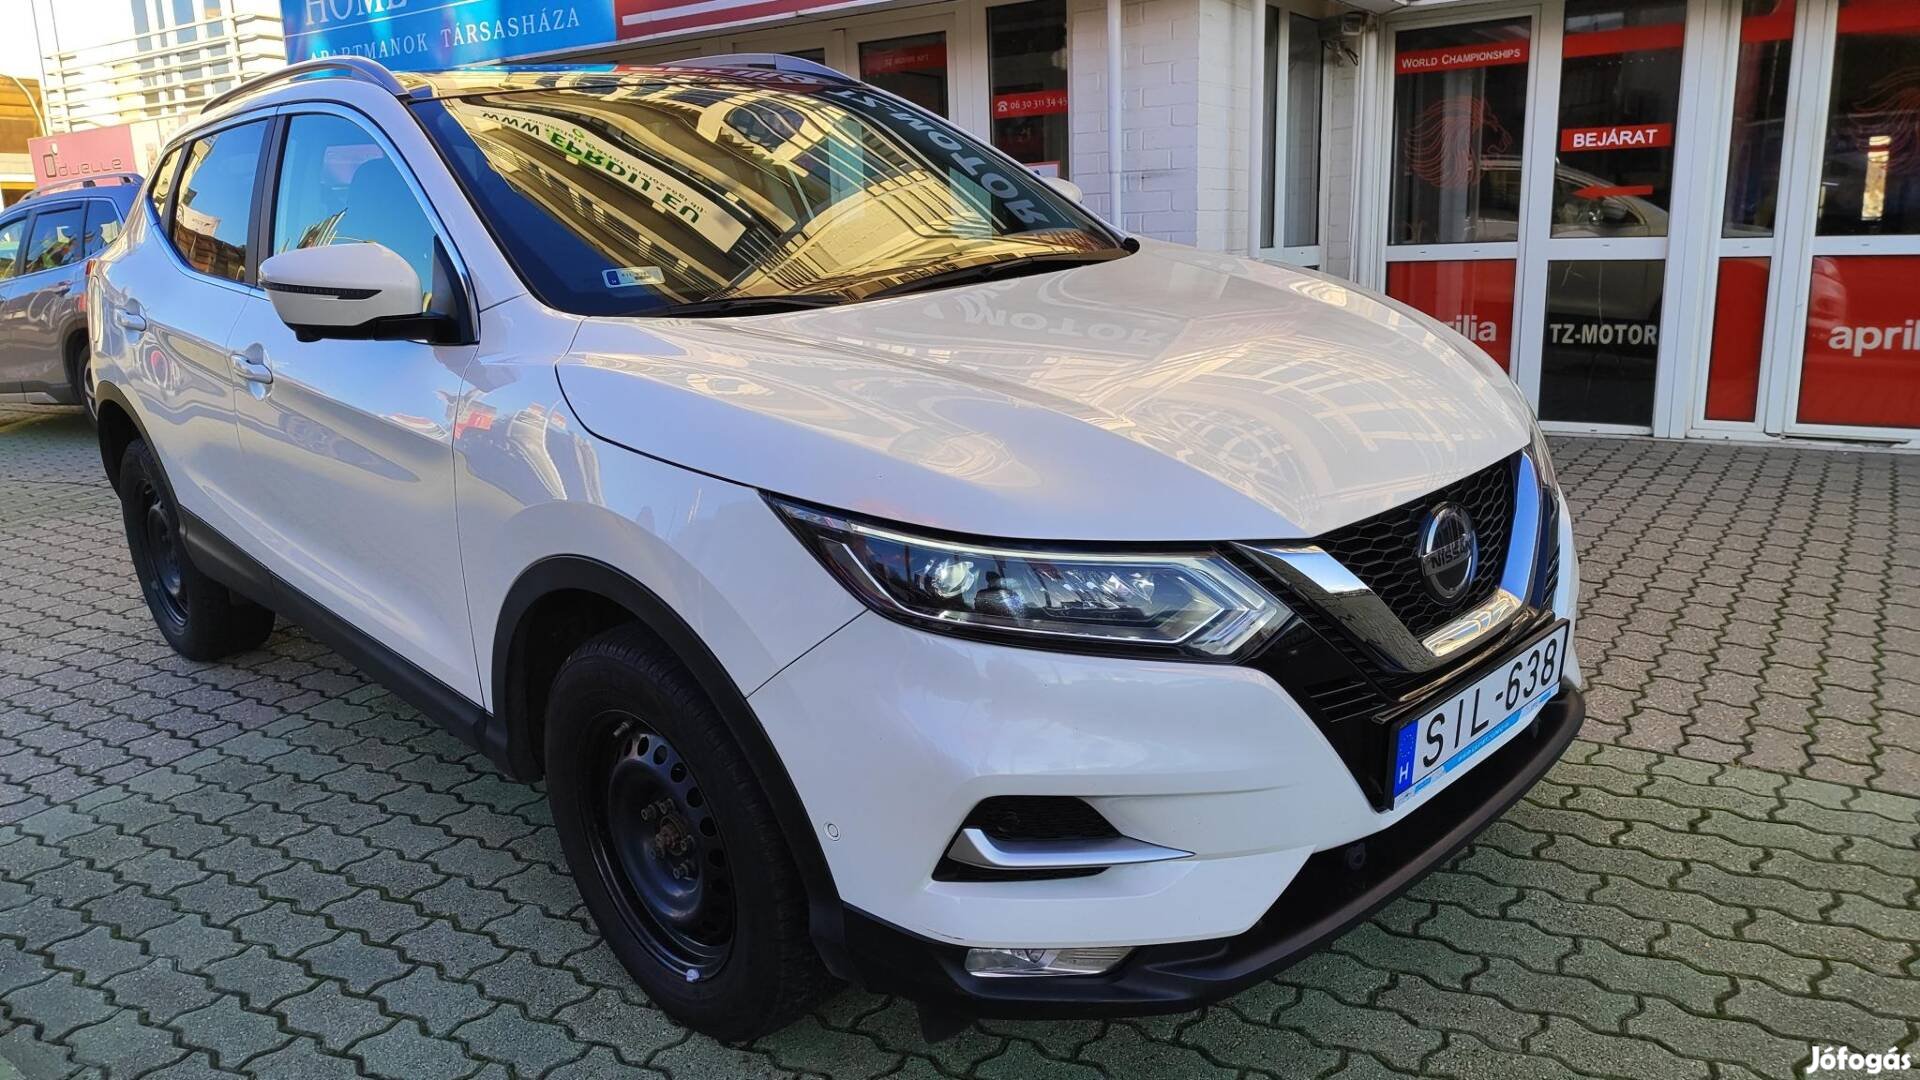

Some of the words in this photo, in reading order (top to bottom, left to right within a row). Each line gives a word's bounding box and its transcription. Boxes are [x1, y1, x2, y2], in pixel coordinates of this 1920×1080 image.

[440, 7, 581, 48] TÁRSASHÁZA
[1573, 128, 1658, 148] BEJÁRAT
[1443, 314, 1497, 342] ilia
[1550, 323, 1658, 345] TZ-MOTOR
[1423, 638, 1557, 767] SIL-638
[1399, 764, 1409, 785] H
